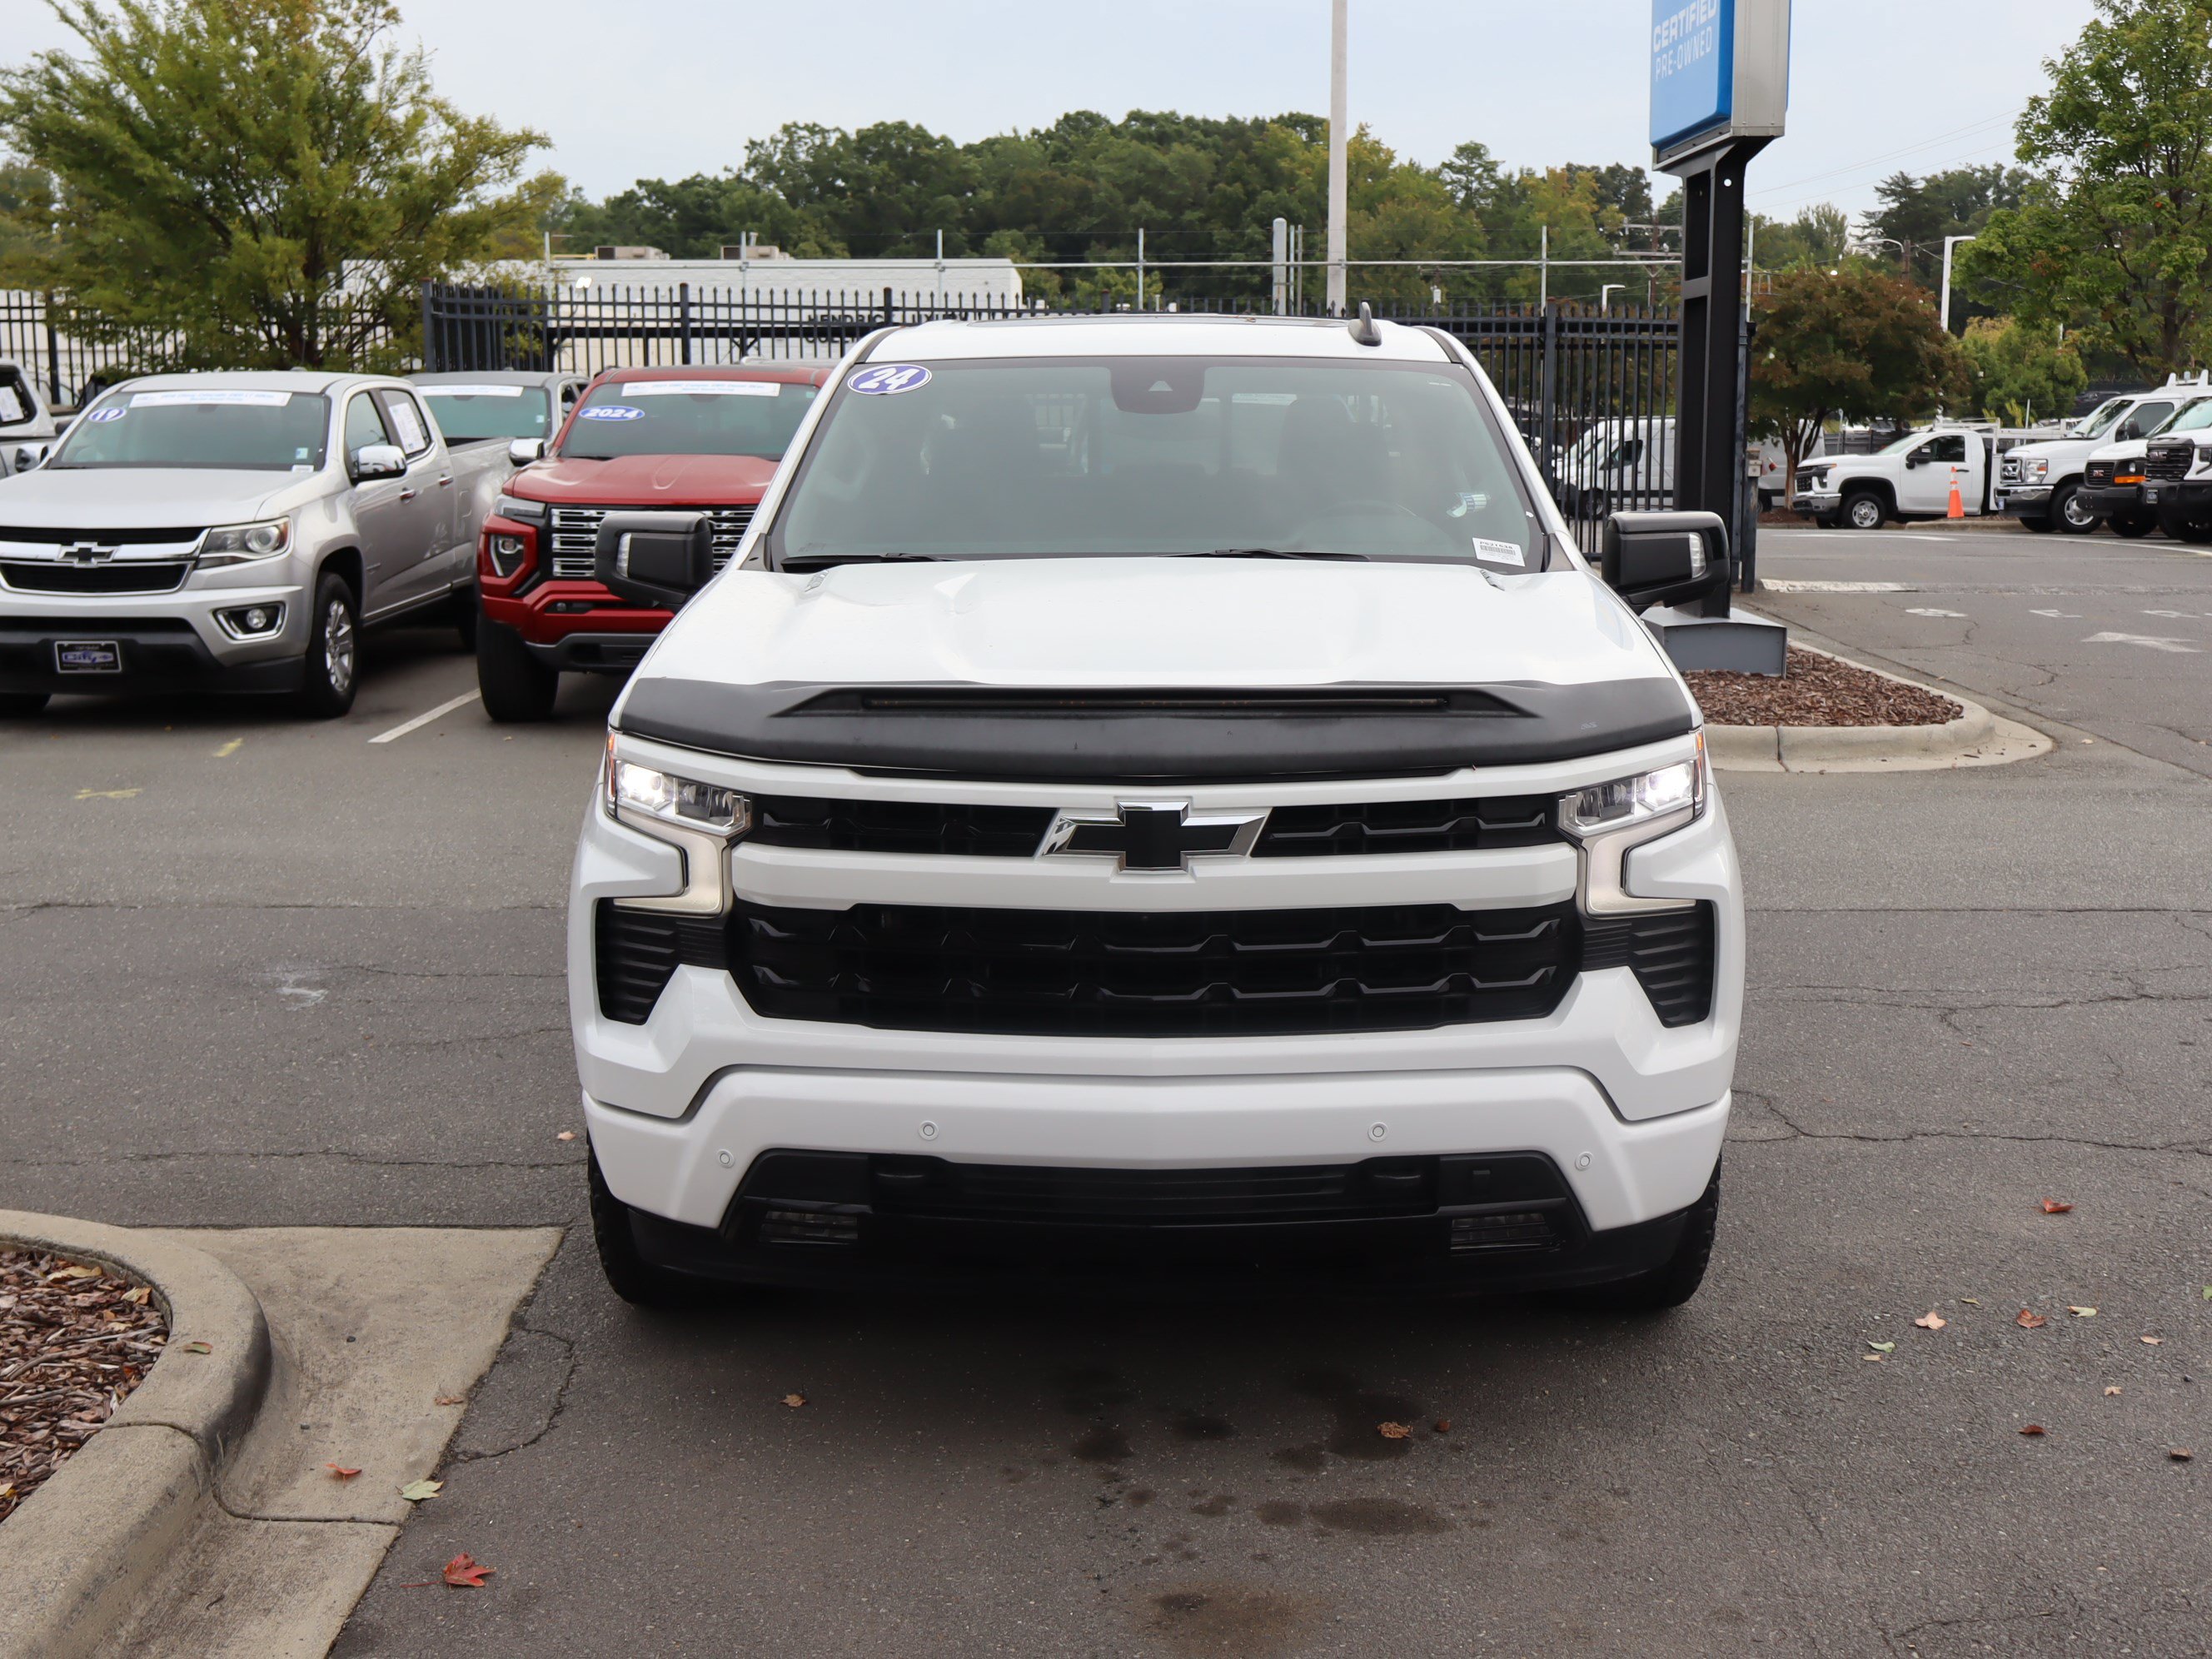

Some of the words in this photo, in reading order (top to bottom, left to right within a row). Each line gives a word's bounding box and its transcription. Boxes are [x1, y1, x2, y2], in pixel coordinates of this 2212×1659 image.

[1653, 0, 1716, 52] CERTIFIED
[1656, 26, 1712, 82] PRE-OWNED
[858, 367, 919, 391] 24
[584, 407, 640, 419] 2024
